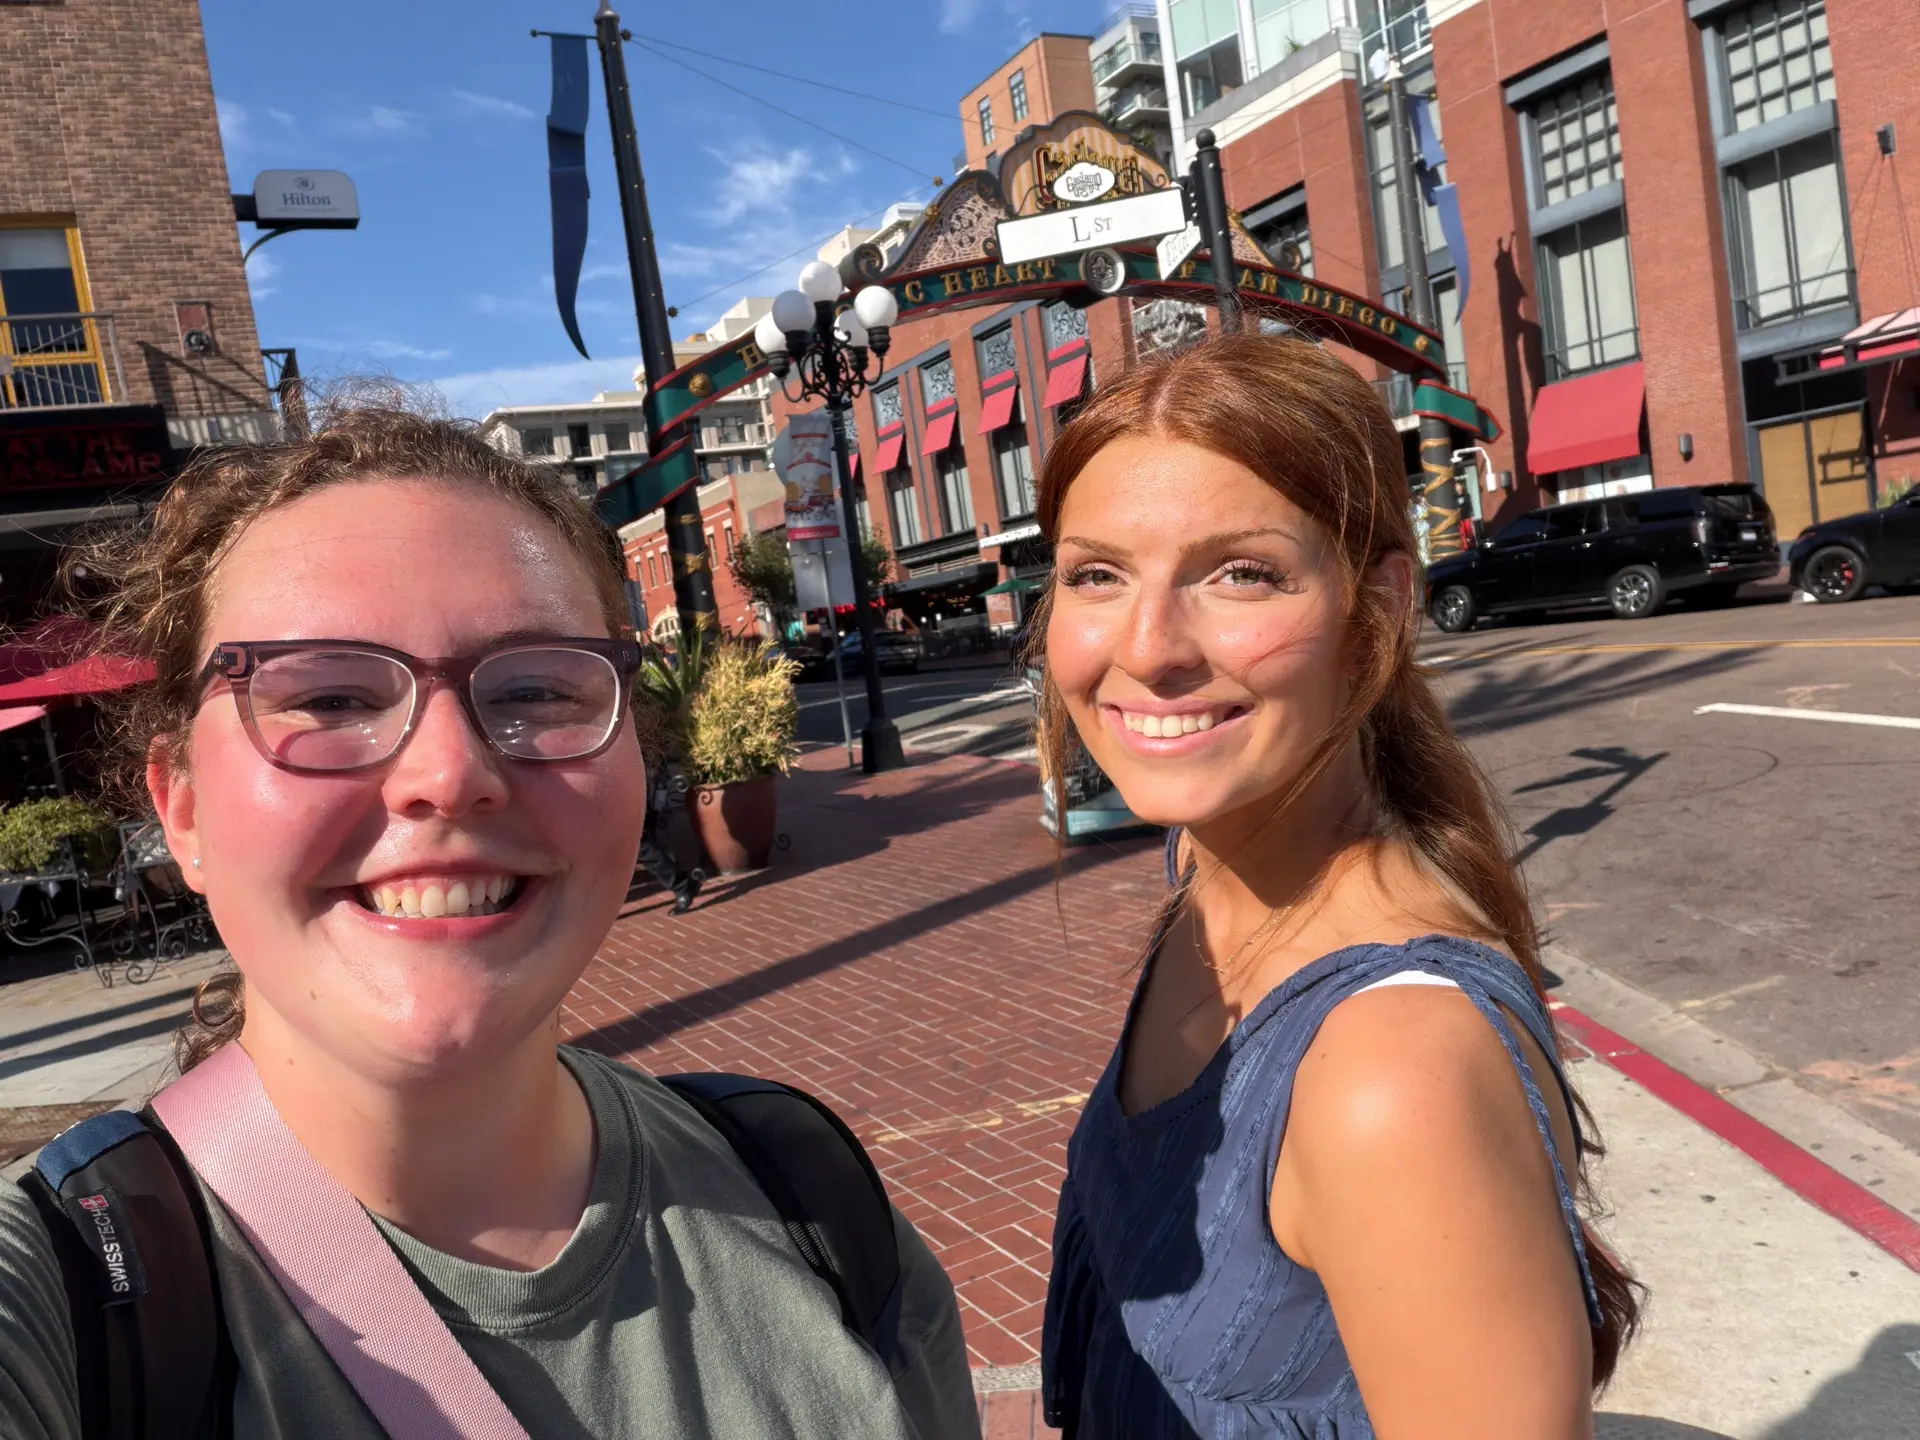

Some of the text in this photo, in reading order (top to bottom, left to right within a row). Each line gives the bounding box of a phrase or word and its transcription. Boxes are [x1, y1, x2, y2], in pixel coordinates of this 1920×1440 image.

[282, 192, 331, 206] Hilton
[1068, 216, 1091, 244] L
[941, 259, 1057, 297] HEART
[1238, 268, 1280, 294] AN
[1301, 283, 1397, 336] DIEGO
[7, 429, 131, 457] AT THE
[0, 452, 161, 482] ASLAMP
[90, 1208, 130, 1292] SWISSTECH
